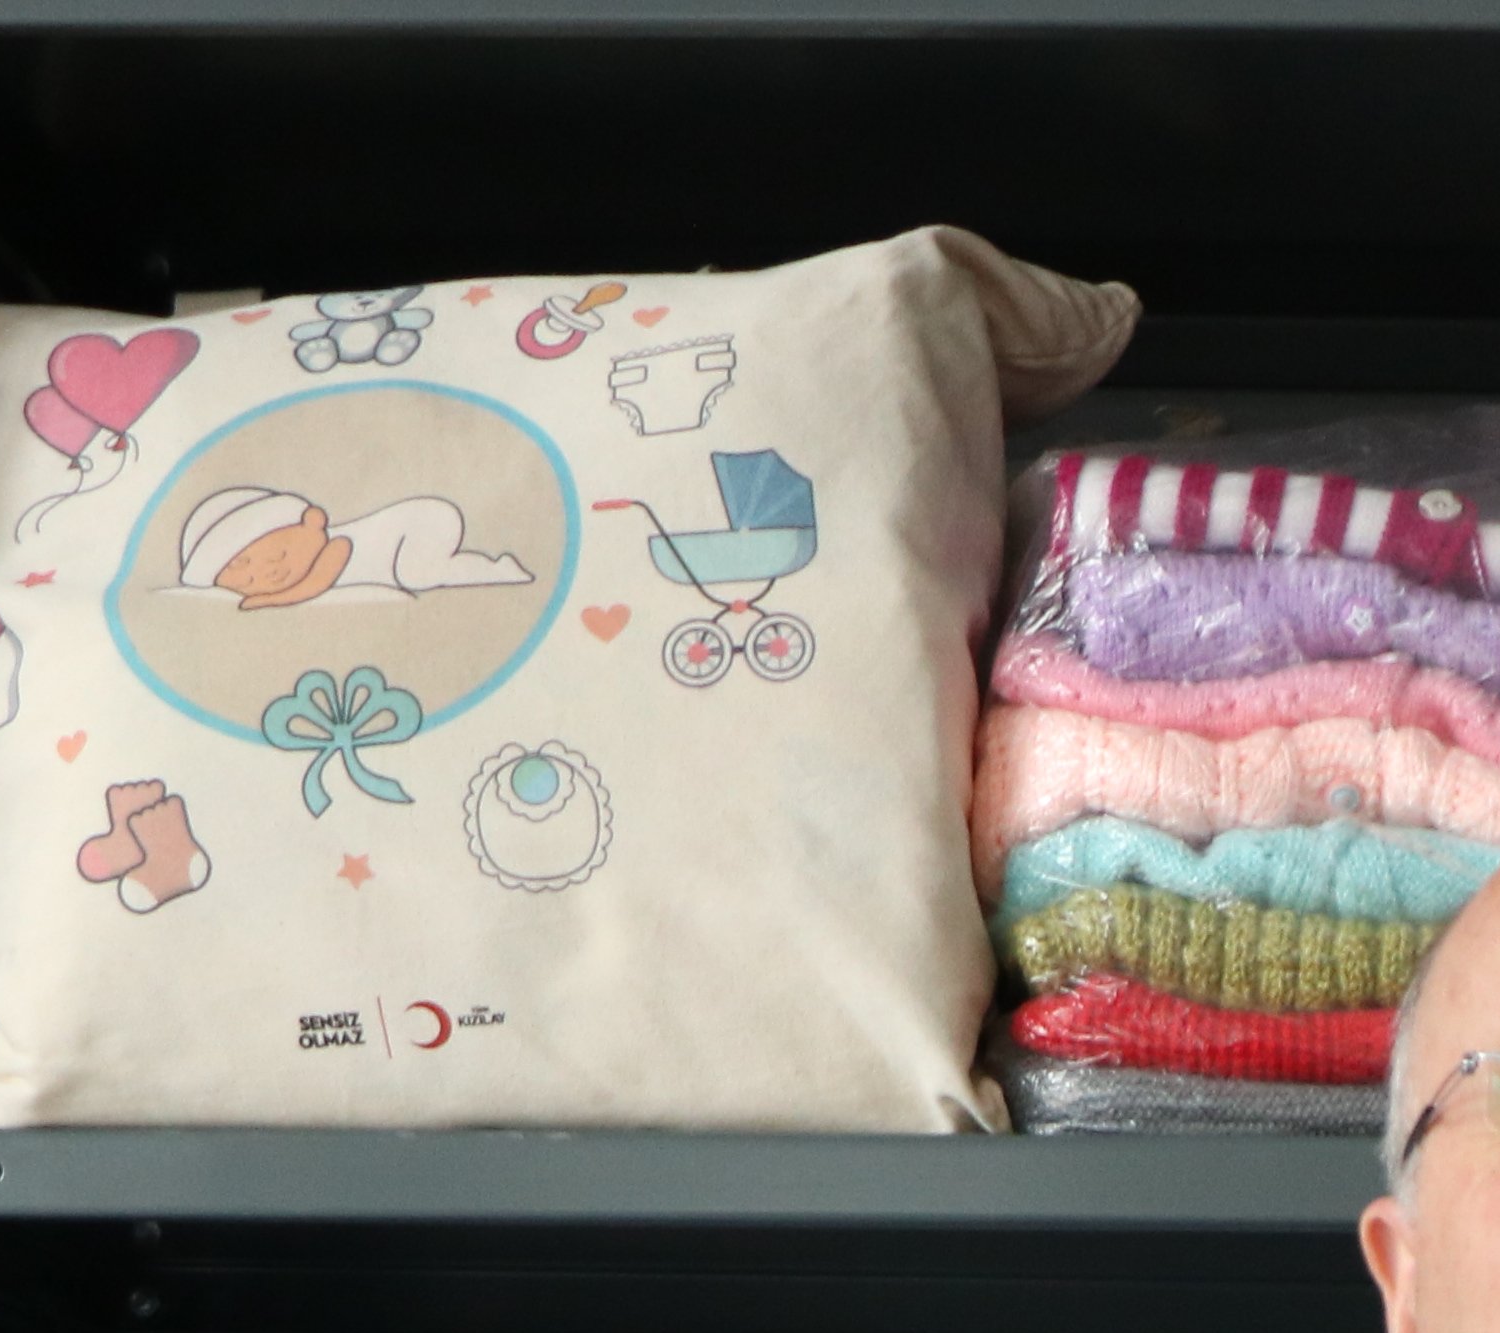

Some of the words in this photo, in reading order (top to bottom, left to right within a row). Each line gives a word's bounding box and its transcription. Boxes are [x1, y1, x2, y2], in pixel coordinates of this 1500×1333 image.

[299, 1010, 363, 1031] SENSİZ
[458, 1012, 505, 1028] KIZILAY
[299, 1029, 366, 1049] OLMAZ
